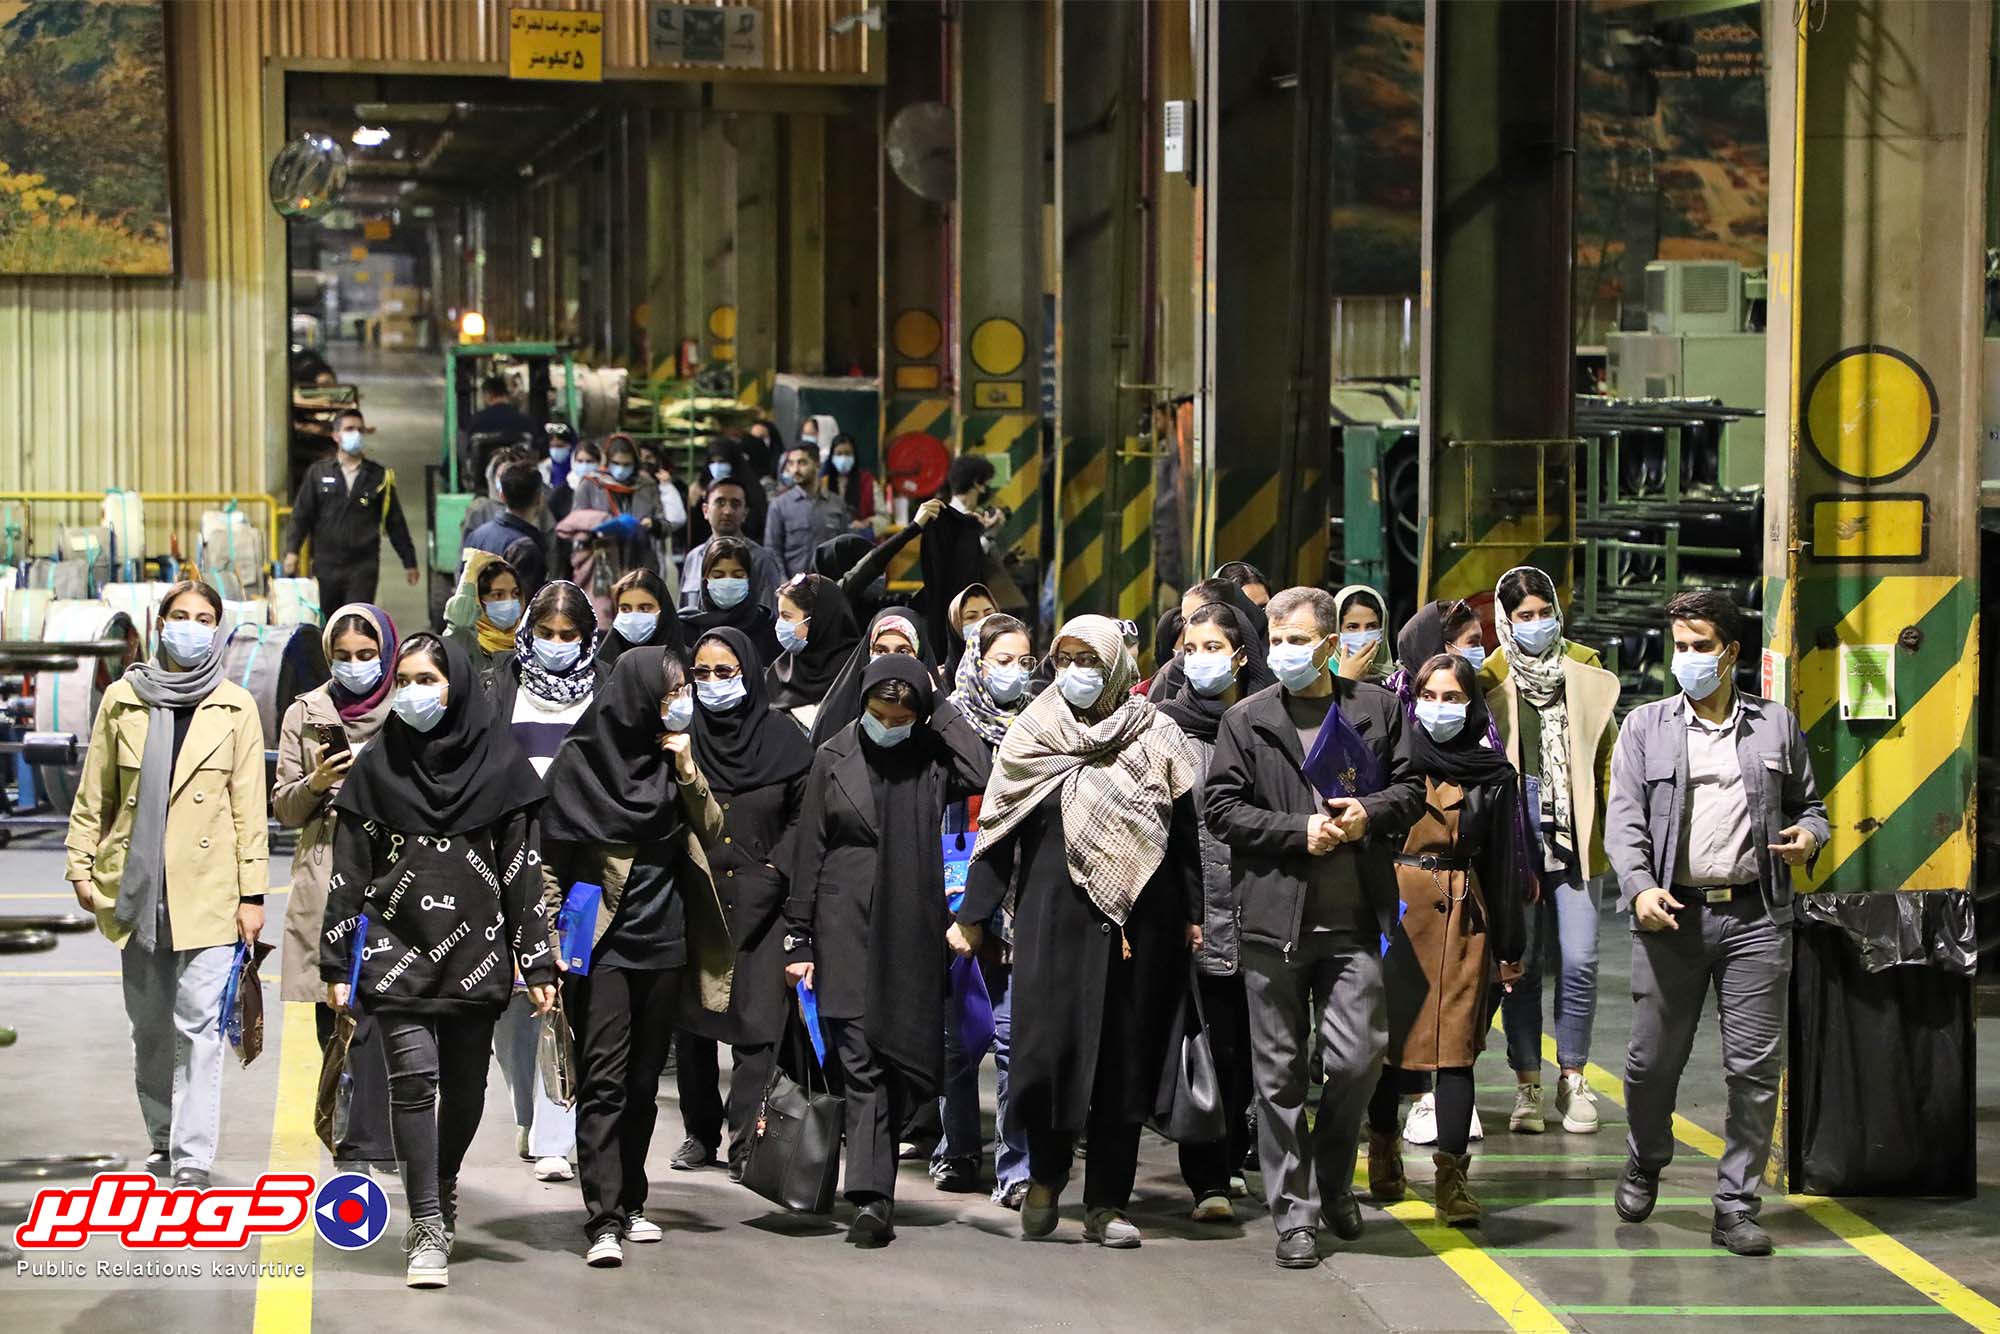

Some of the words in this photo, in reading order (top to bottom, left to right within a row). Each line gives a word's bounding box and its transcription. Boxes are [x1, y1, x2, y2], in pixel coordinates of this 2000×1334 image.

[545, 21, 570, 37] سرعت
[572, 20, 601, 38] حداکثر
[573, 50, 584, 69] ۵
[428, 921, 471, 963] DHUIYI
[374, 945, 422, 993] REDHUIYI
[459, 951, 500, 992] DHUIYI
